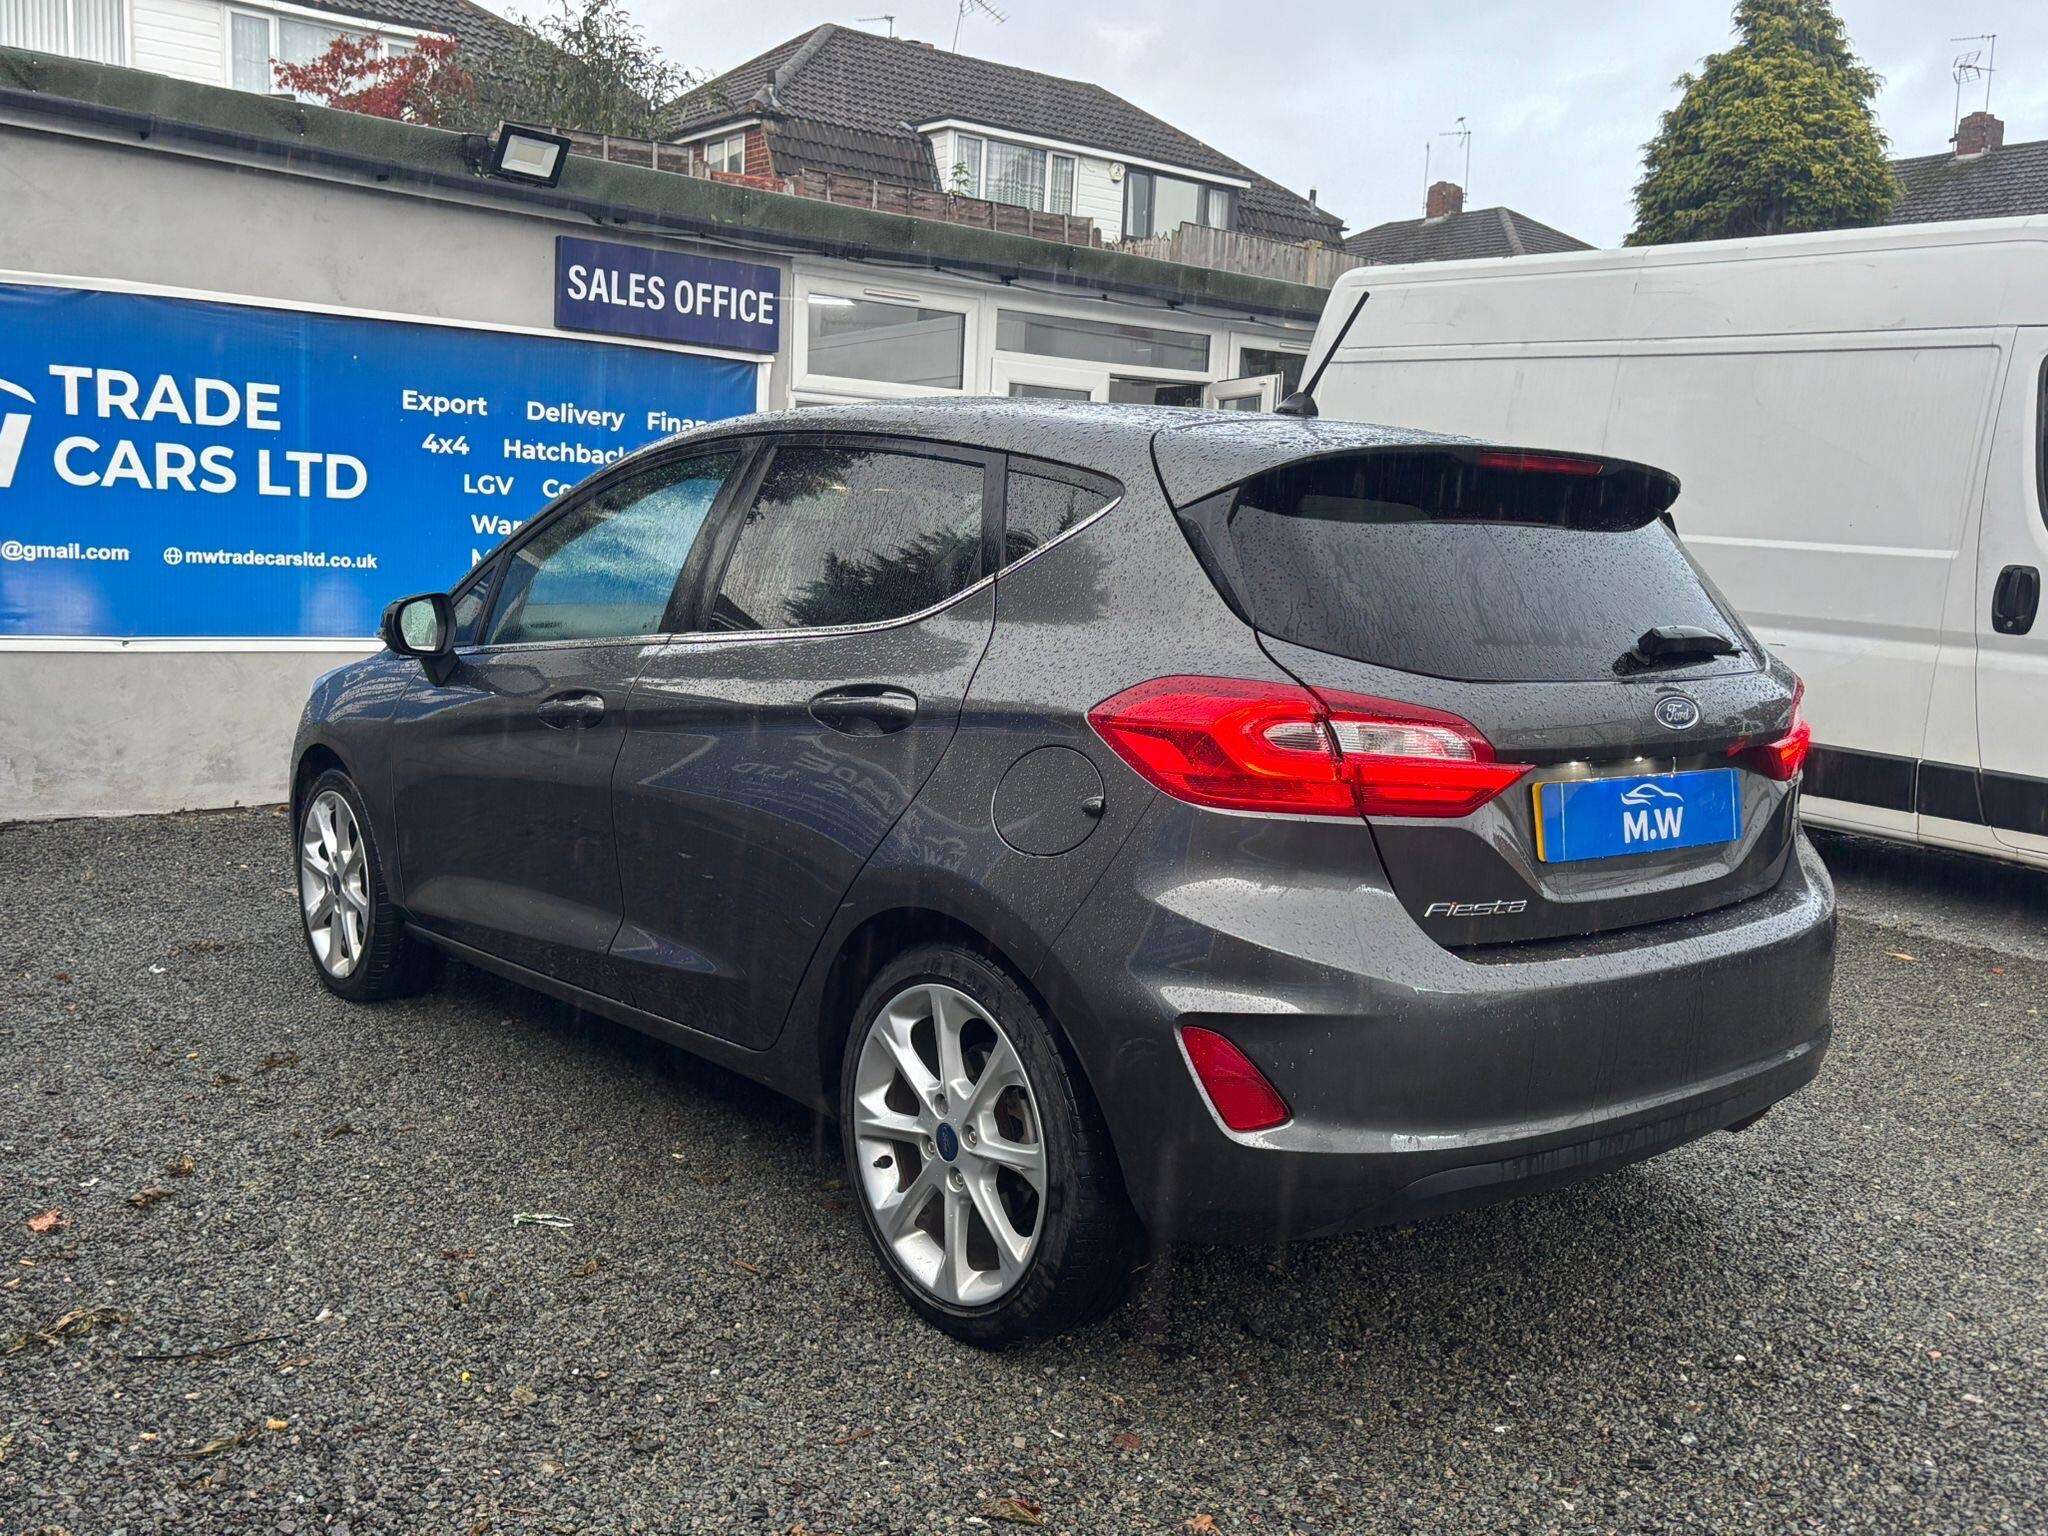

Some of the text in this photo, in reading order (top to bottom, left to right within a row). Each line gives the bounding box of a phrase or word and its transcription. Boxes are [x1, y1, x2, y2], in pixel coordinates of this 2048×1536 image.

[567, 264, 775, 325] SALES OFFICE
[48, 364, 281, 431] TRADE
[402, 389, 488, 417] Export
[526, 400, 626, 432] Delivery
[421, 433, 470, 456] 4x4
[53, 435, 237, 494] CARS
[258, 449, 368, 499] LTD
[463, 473, 514, 496] LGV
[0, 540, 378, 569] @gmail.com mwtradecarsltd.co.uk
[1622, 806, 1684, 844] M.W
[1424, 900, 1528, 918] Fiesta
